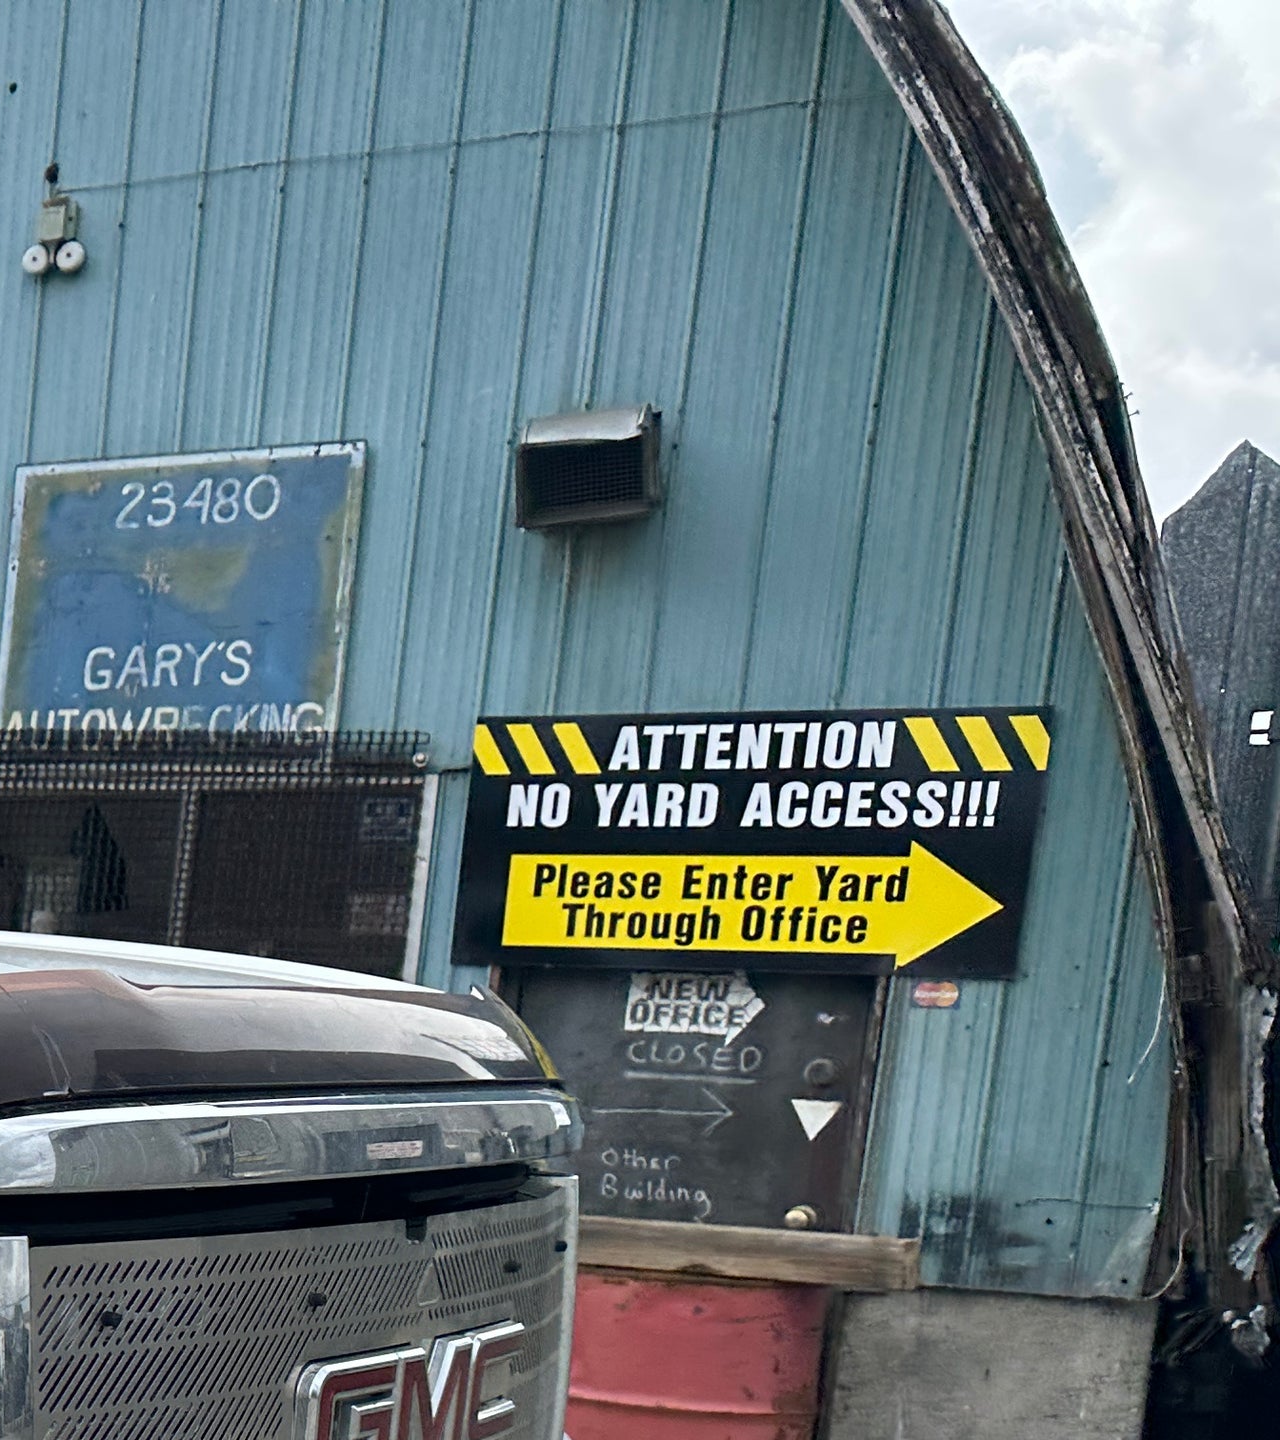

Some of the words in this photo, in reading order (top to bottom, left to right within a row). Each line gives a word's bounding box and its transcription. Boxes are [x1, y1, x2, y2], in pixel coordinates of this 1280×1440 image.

[115, 474, 282, 529] 23480
[83, 640, 253, 692] GARY'S
[607, 720, 898, 772] ATTENTION
[506, 782, 570, 829] NO
[593, 782, 721, 829] YARD
[740, 780, 1001, 829] ACCESS!!!
[533, 863, 661, 900] Please
[682, 864, 794, 901] Enter
[815, 865, 909, 903] Yard
[561, 902, 721, 947] Through
[741, 905, 869, 944] Office
[647, 978, 730, 1000] NEW
[629, 999, 748, 1027] OFFICE
[627, 1040, 763, 1073] CLOSED
[601, 1172, 712, 1221] Building
